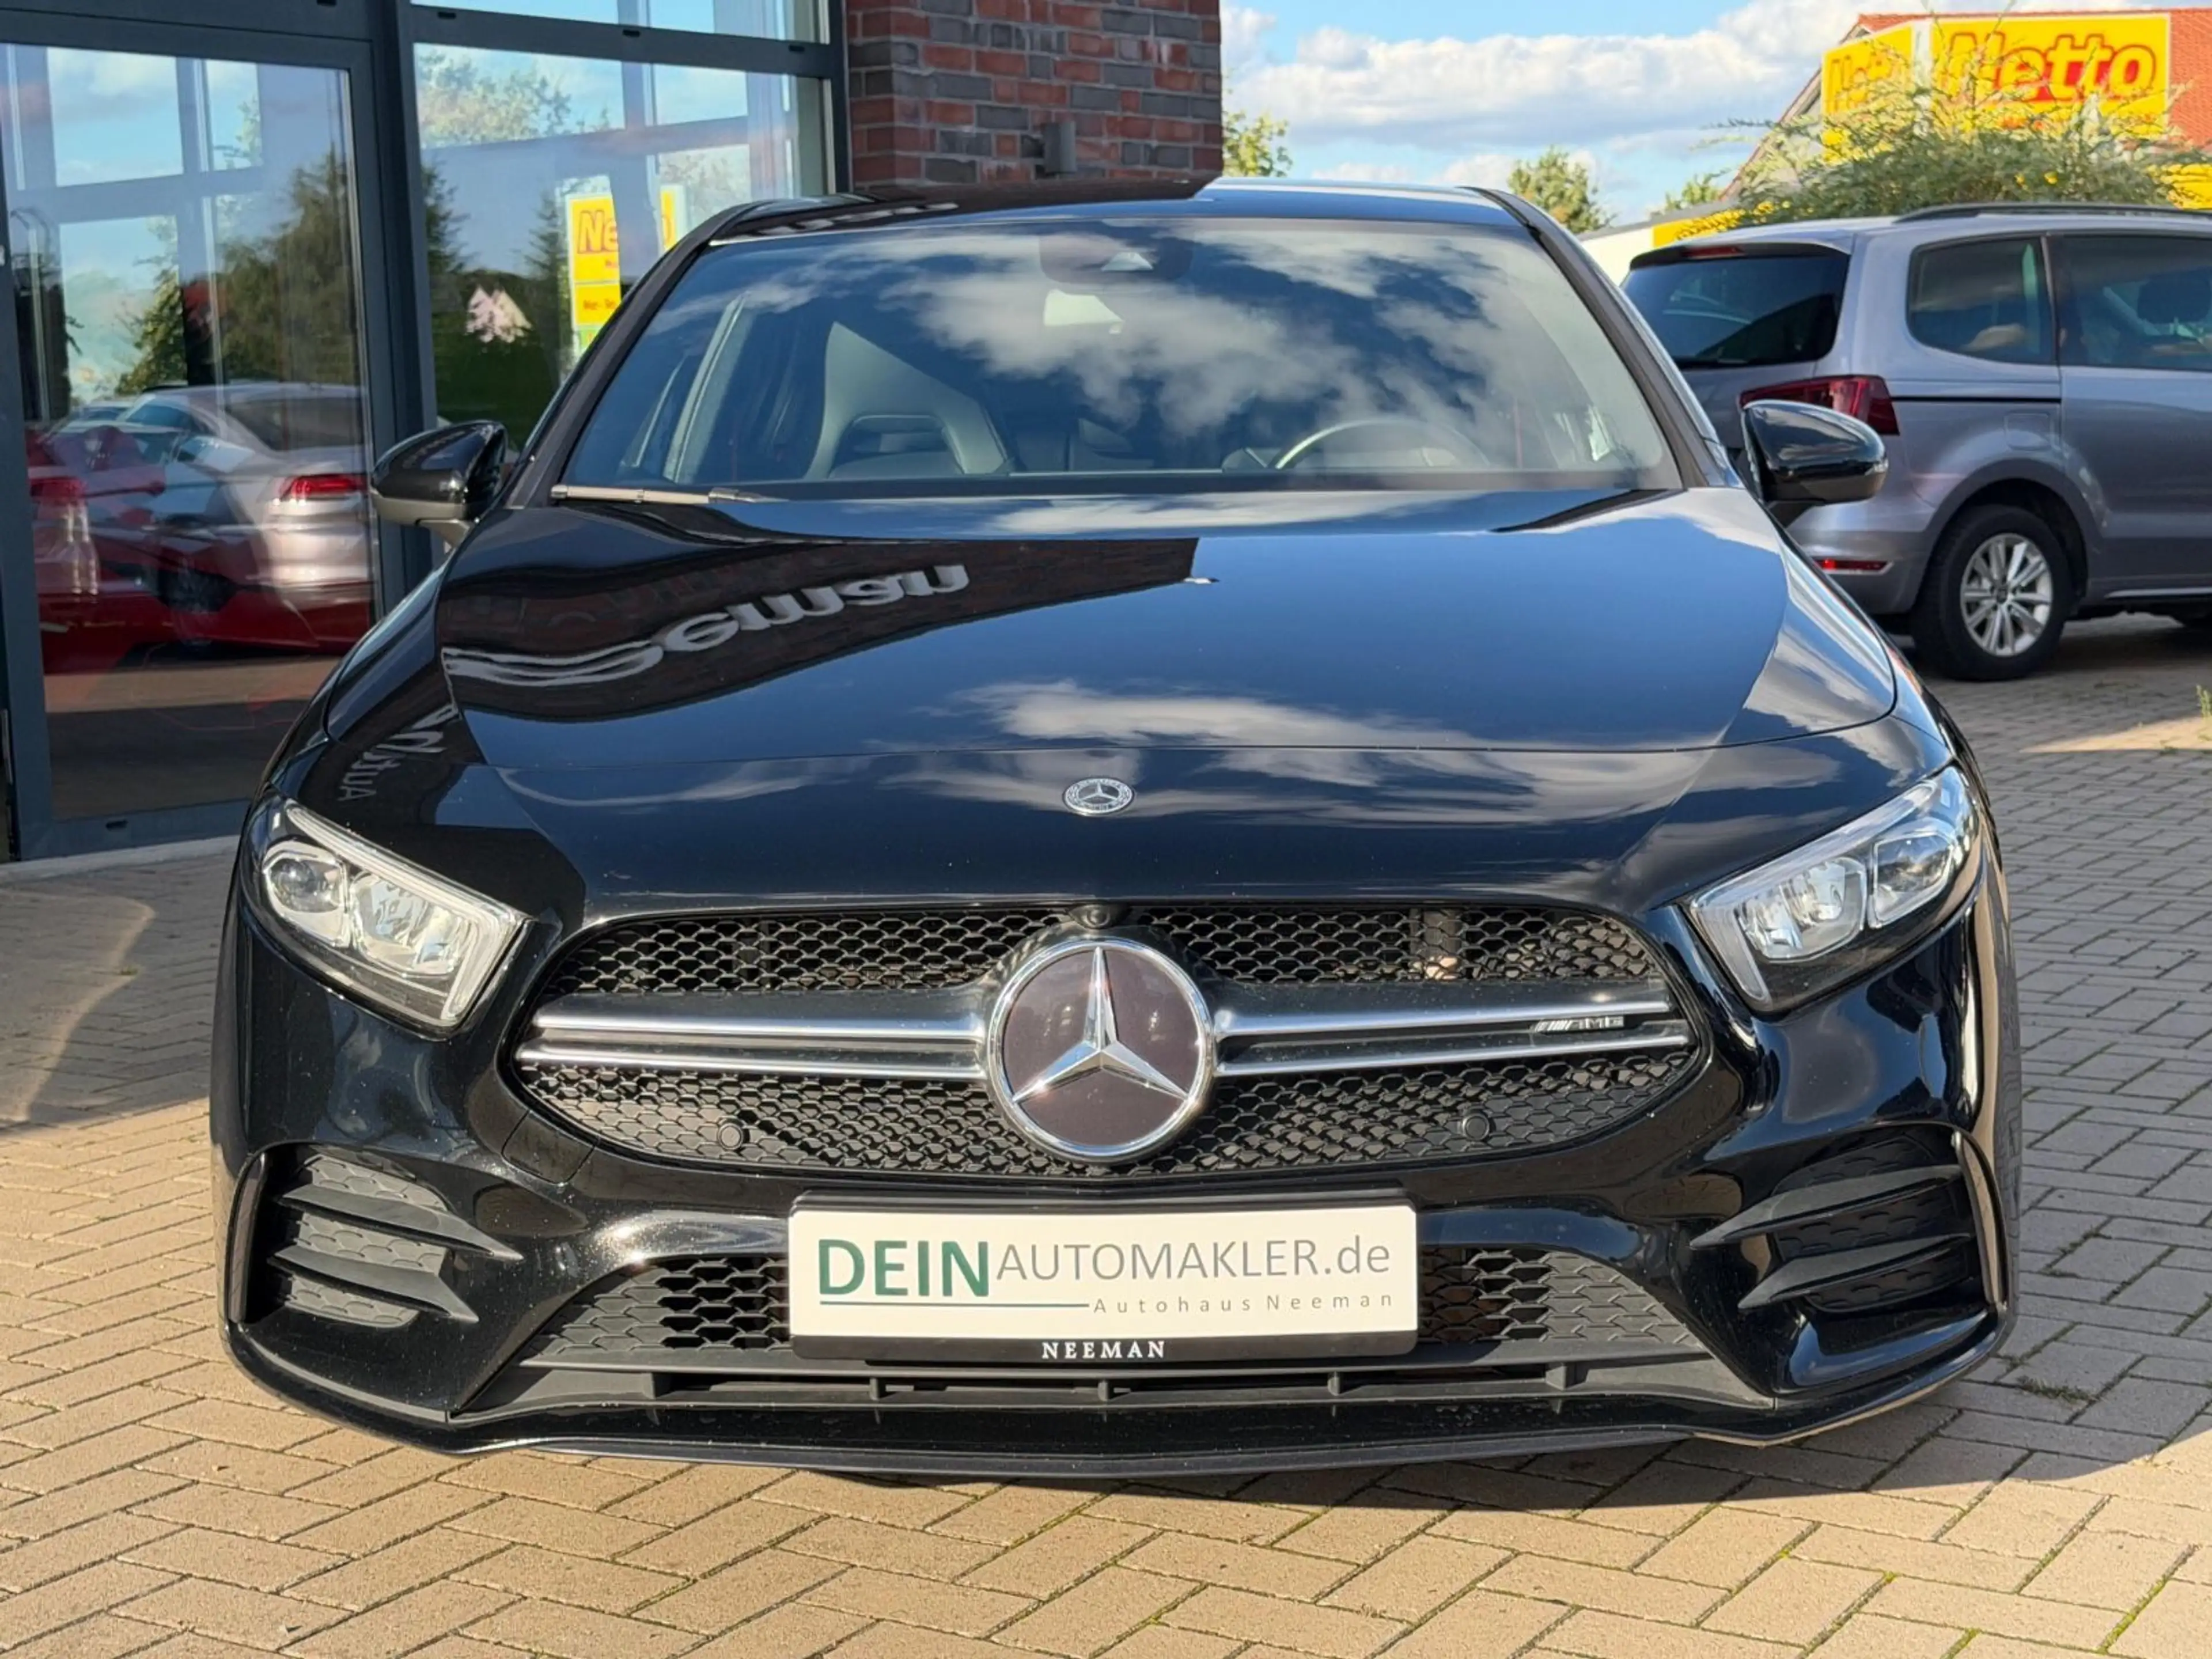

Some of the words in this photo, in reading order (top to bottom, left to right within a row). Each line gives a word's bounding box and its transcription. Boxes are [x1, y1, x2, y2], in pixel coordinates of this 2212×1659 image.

[1938, 31, 2158, 101] Netto
[1093, 1296, 1251, 1314] Autohaus
[1266, 1293, 1392, 1310] Neeman
[1041, 1340, 1165, 1359] NEEMAN
